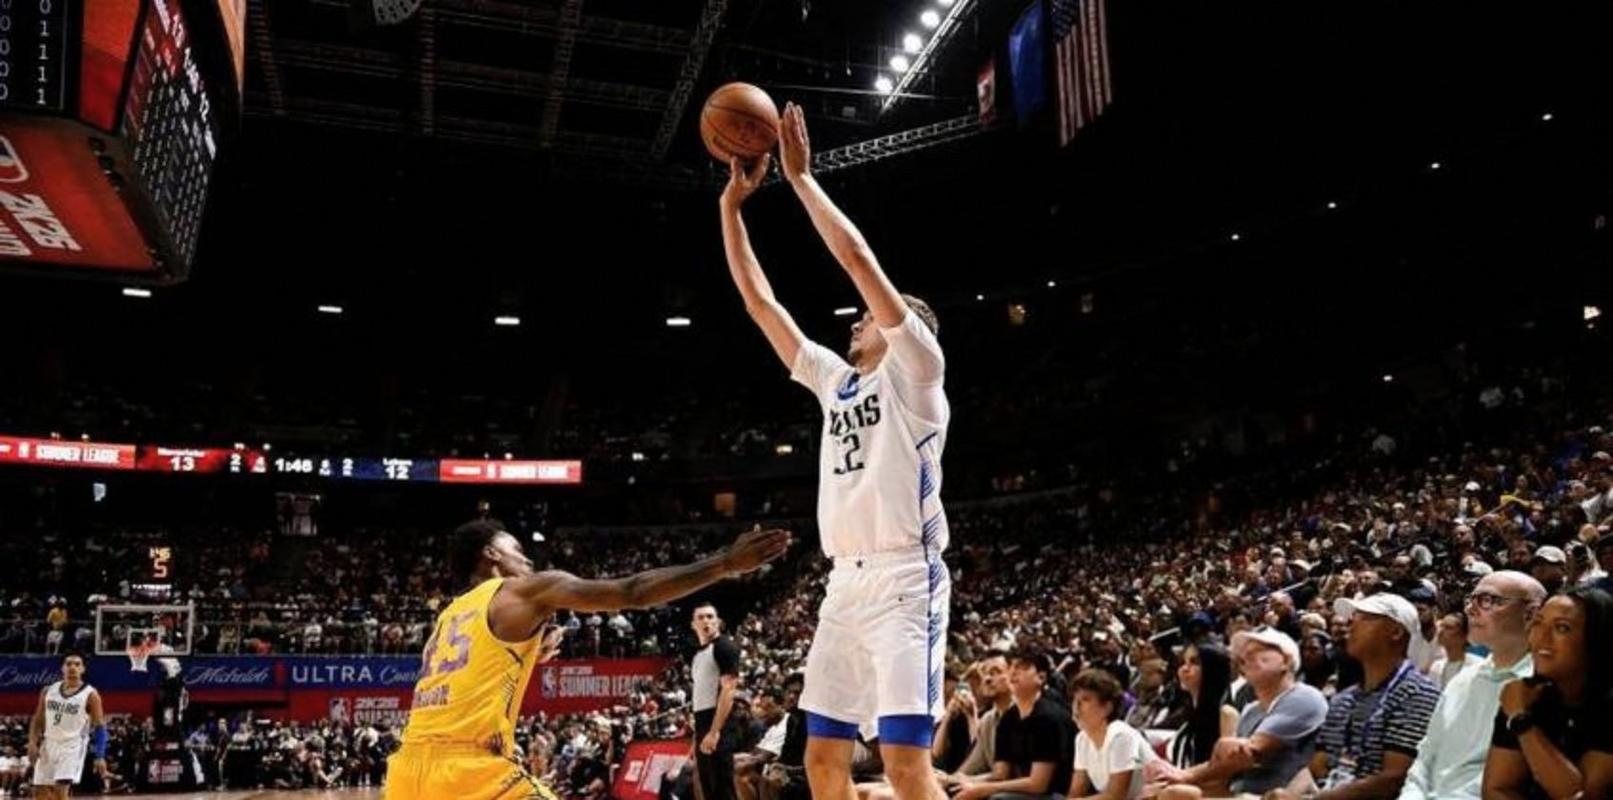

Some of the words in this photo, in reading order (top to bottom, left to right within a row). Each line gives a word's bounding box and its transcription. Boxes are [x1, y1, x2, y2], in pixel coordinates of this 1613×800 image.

[40, 20, 50, 37] 1
[39, 43, 50, 60] 1
[38, 66, 49, 83] 1
[37, 88, 48, 105] 1
[170, 455, 195, 471] 13
[385, 465, 410, 479] 12
[153, 559, 168, 578] 5
[292, 665, 373, 683] ULTRA
[558, 676, 611, 697] SUMMER
[53, 713, 62, 726] 9
